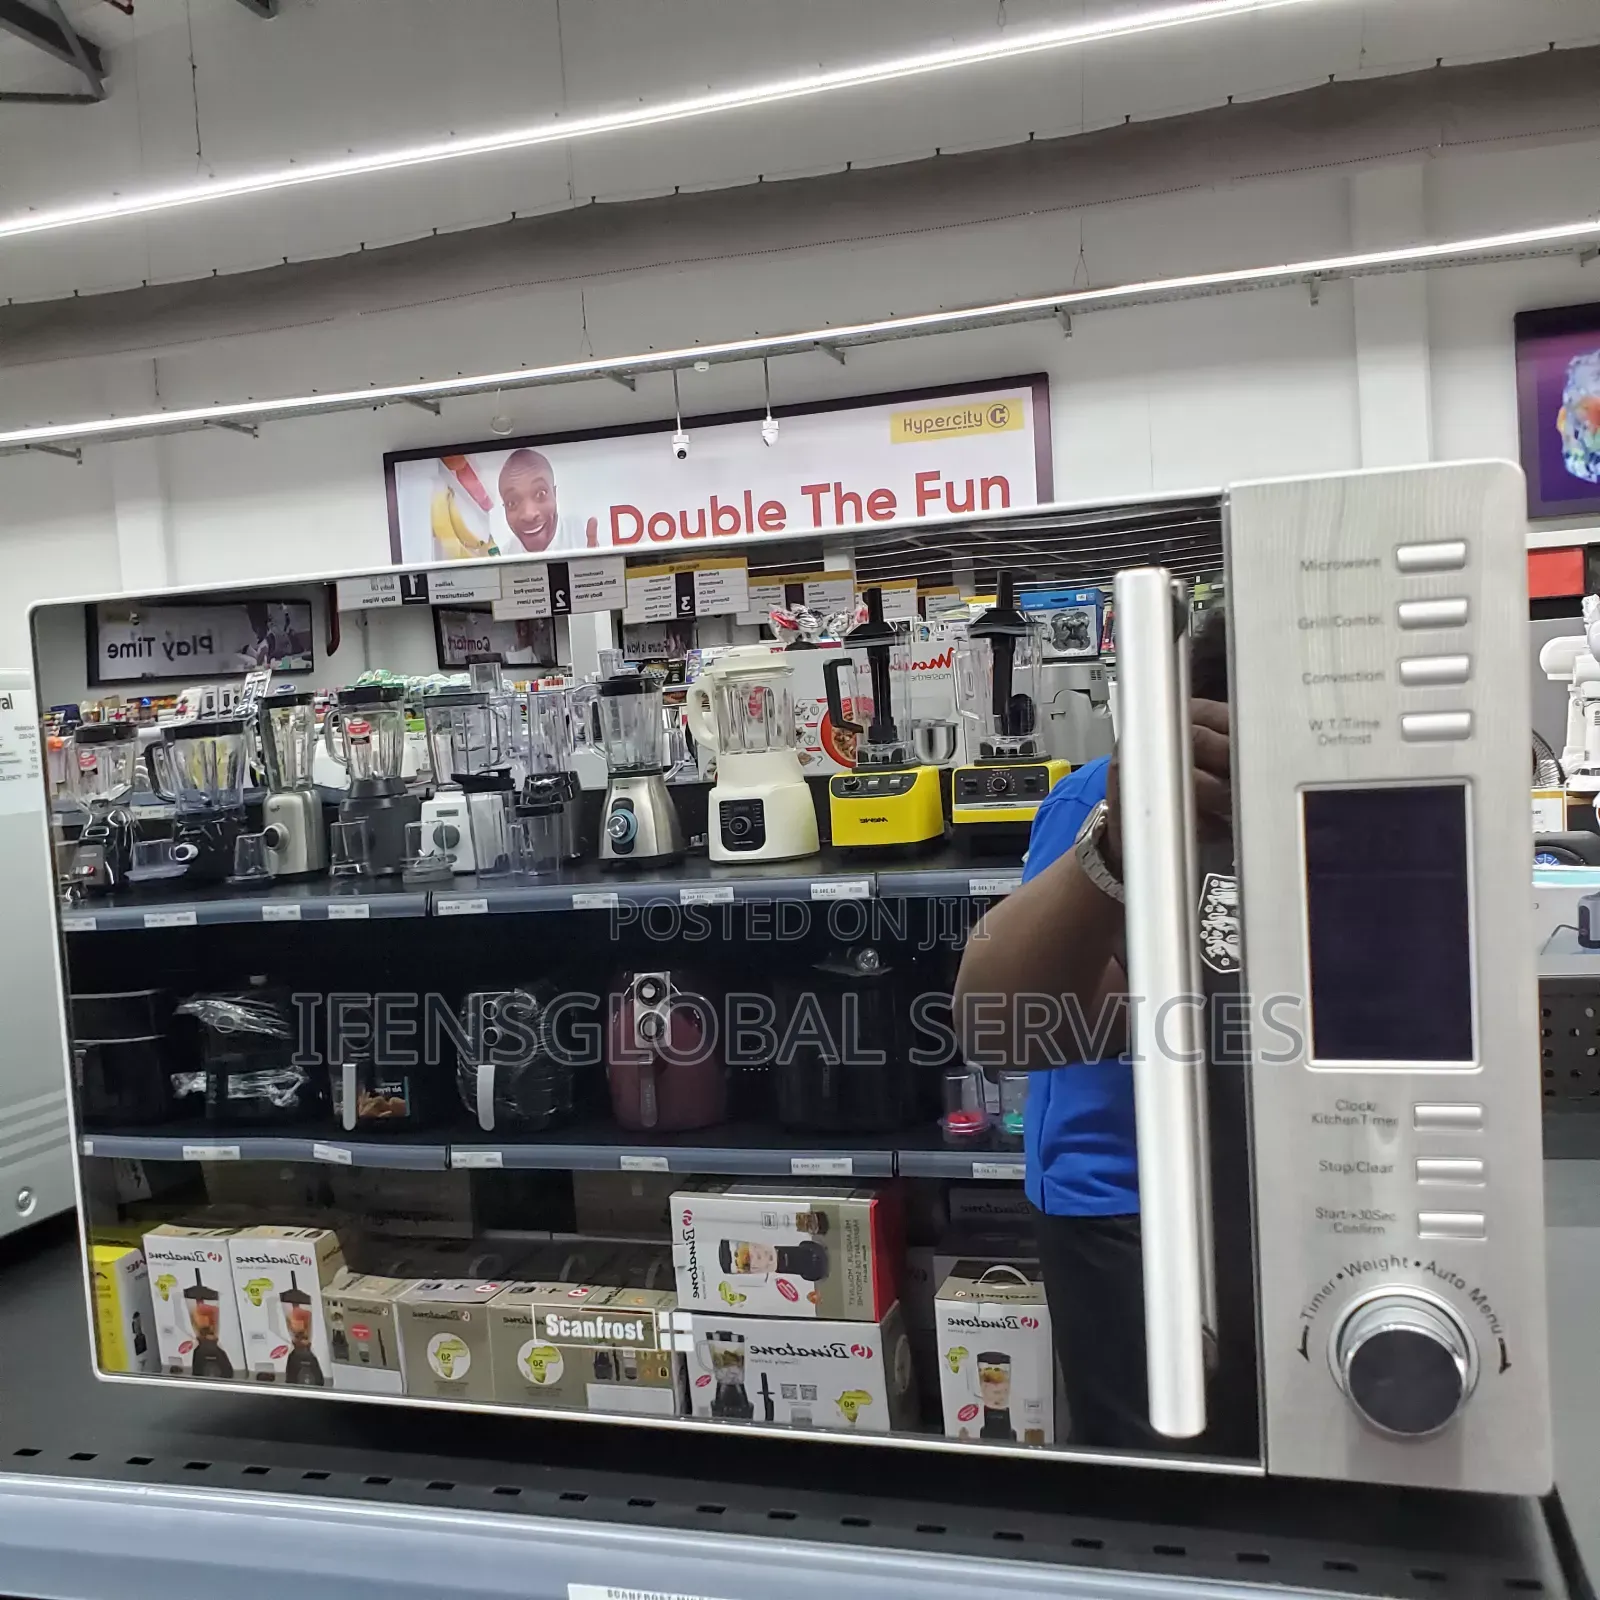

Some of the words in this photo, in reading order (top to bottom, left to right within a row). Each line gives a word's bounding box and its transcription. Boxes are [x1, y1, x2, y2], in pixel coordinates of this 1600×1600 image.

[903, 411, 983, 434] Hypercity
[609, 488, 787, 546] Double
[800, 481, 897, 528] The
[915, 470, 1011, 517] Fun
[1300, 558, 1381, 572] Microwave
[1301, 671, 1385, 685] Convection
[1318, 734, 1372, 746] Defrost
[1311, 1113, 1361, 1126] Kitchen
[1361, 1114, 1399, 1127] Timer
[1318, 1160, 1394, 1175] Stop/Clear
[1300, 1277, 1337, 1320] Timer
[1344, 1255, 1409, 1278] Weight
[1425, 1260, 1466, 1291] Auto
[1468, 1287, 1505, 1335] Menu
[545, 1311, 646, 1343] Scanfrost
